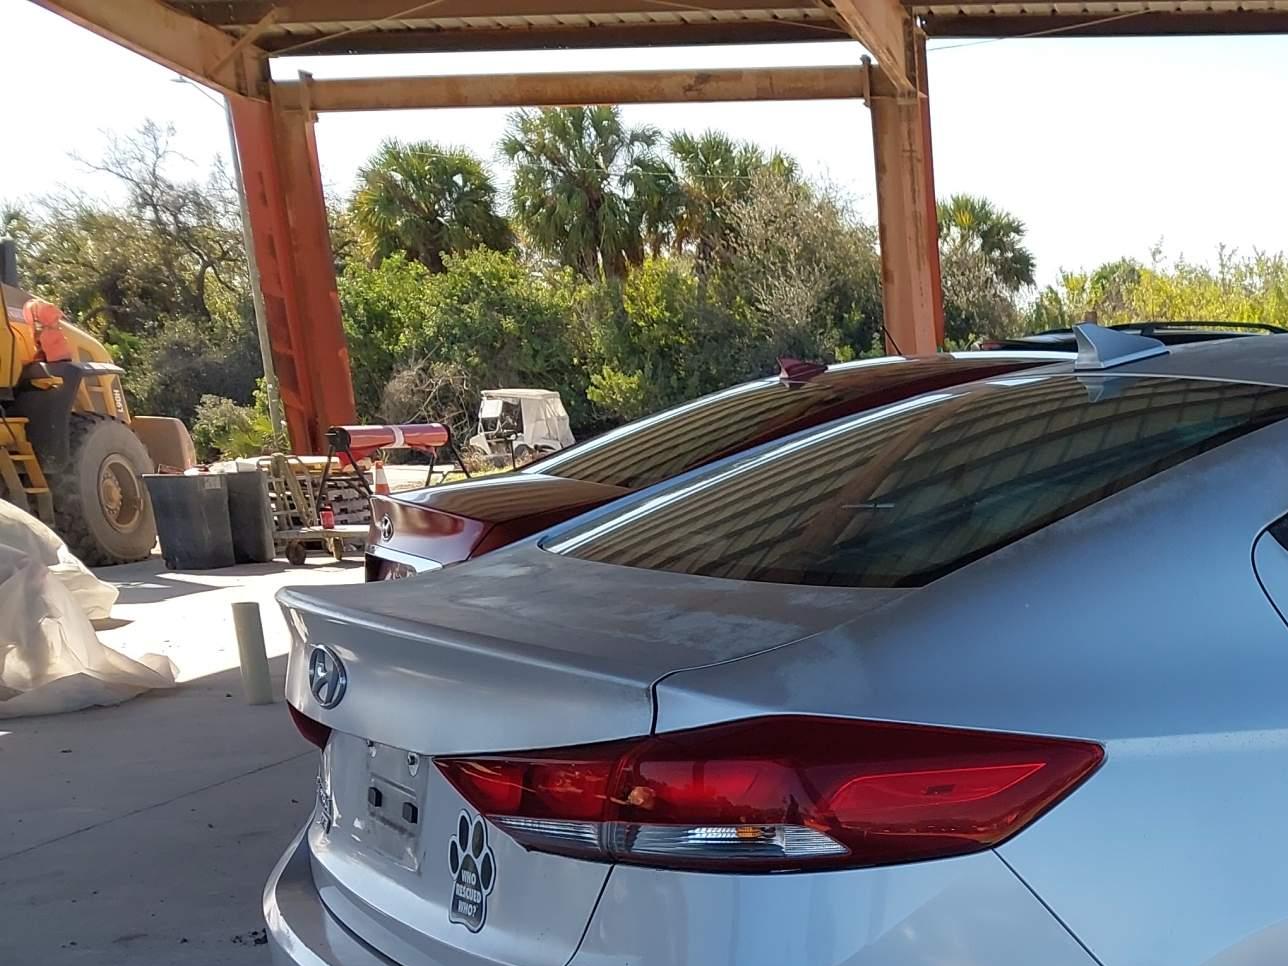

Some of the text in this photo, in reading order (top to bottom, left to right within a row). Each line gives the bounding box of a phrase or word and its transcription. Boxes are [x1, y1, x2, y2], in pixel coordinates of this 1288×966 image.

[461, 870, 477, 885] WHO
[455, 883, 482, 904] RESCUED
[458, 900, 477, 917] WHO?
